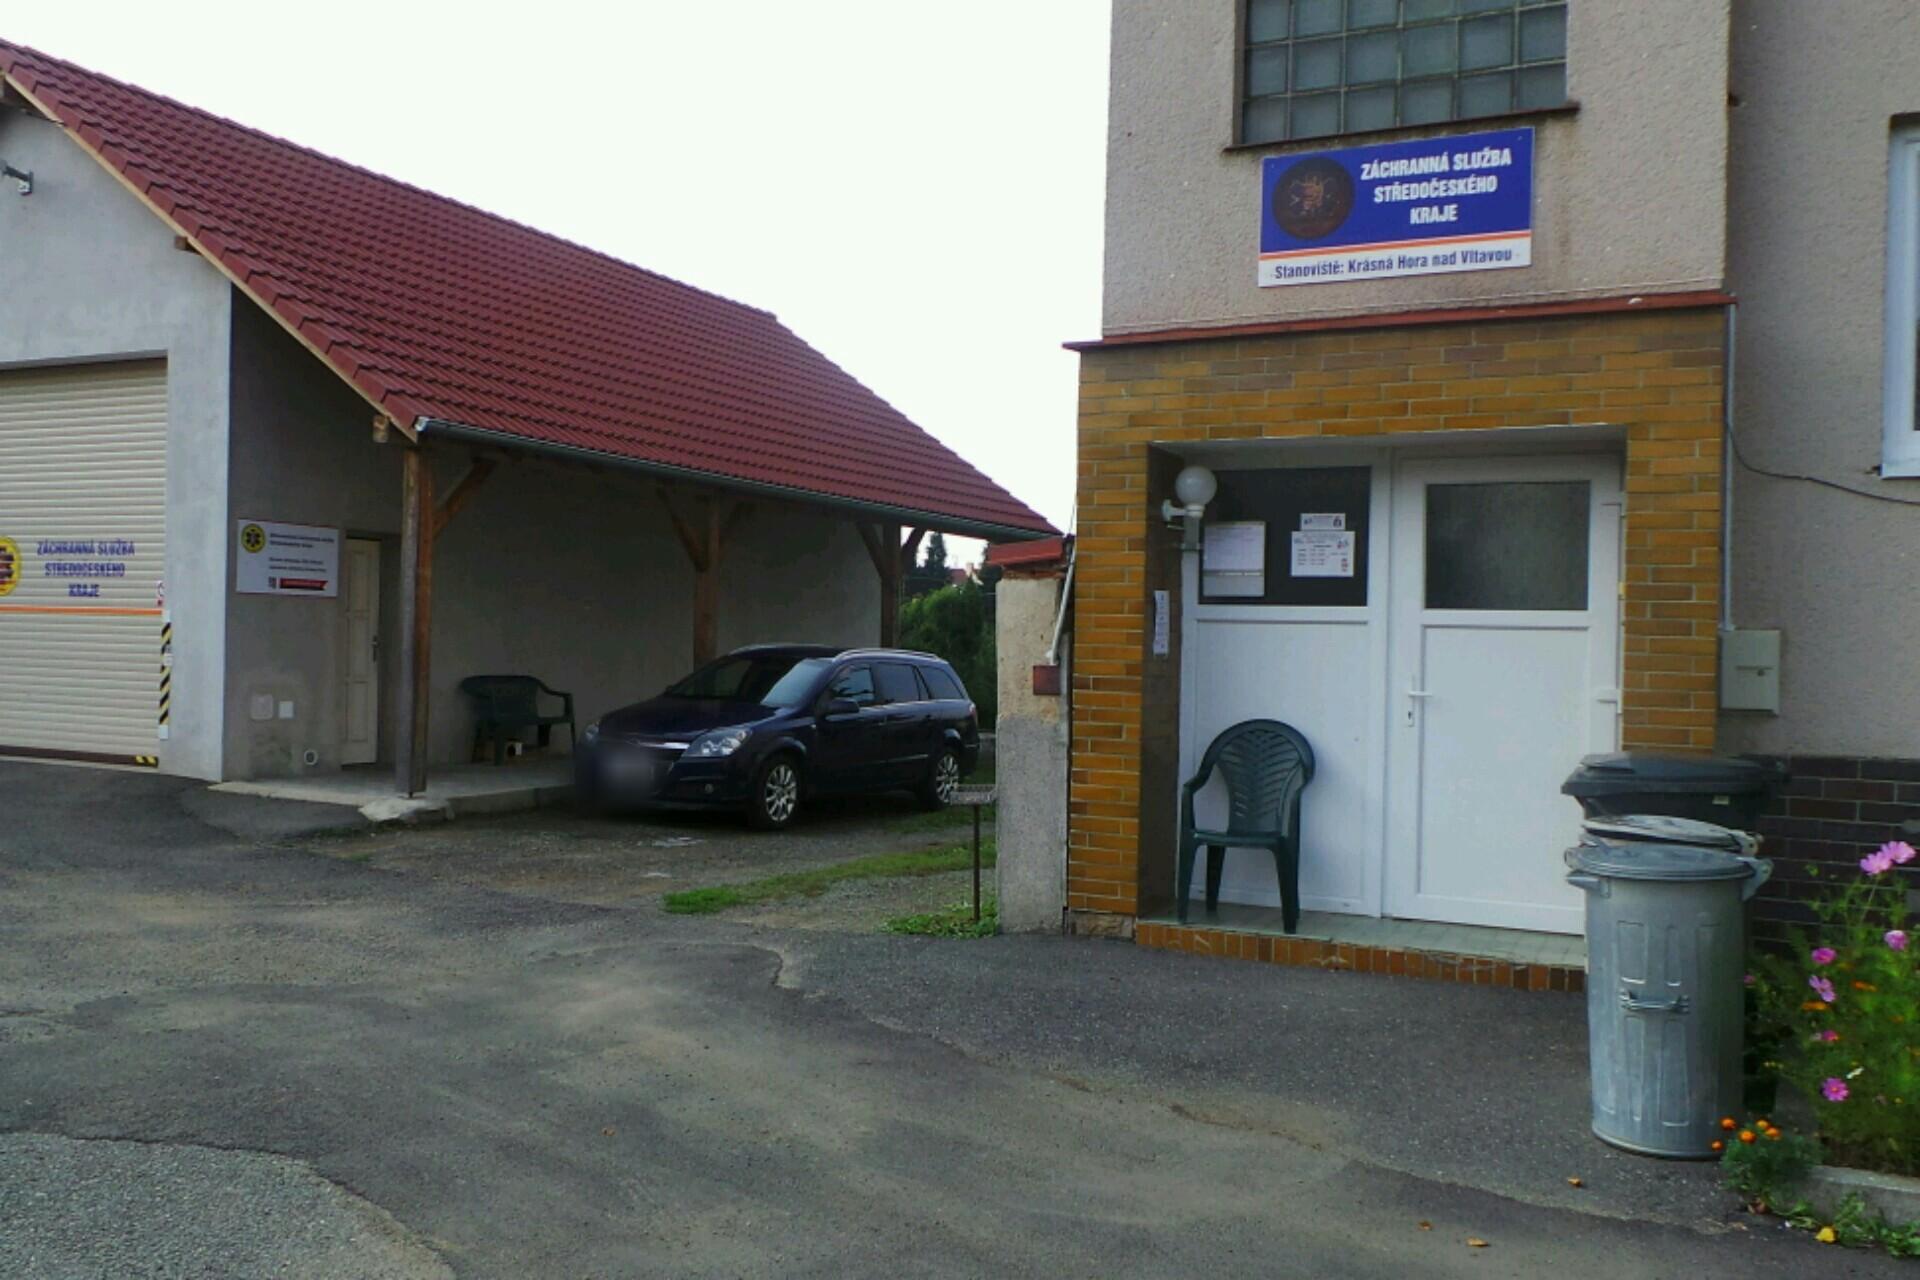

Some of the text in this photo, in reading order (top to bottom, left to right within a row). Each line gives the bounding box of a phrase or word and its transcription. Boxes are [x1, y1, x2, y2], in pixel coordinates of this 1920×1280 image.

[1360, 147, 1512, 180] ZÁCHRANNÁ SLUŽBA
[1374, 174, 1498, 203] STŘEDOČESKÉHO
[1410, 204, 1459, 224] KRAJE
[1275, 249, 1512, 279] Stanoviště: Krásná Hora nad Vltavou
[37, 538, 135, 555] ZÁCHRANNÁ SLUŽBA
[69, 584, 100, 597] KRAJE
